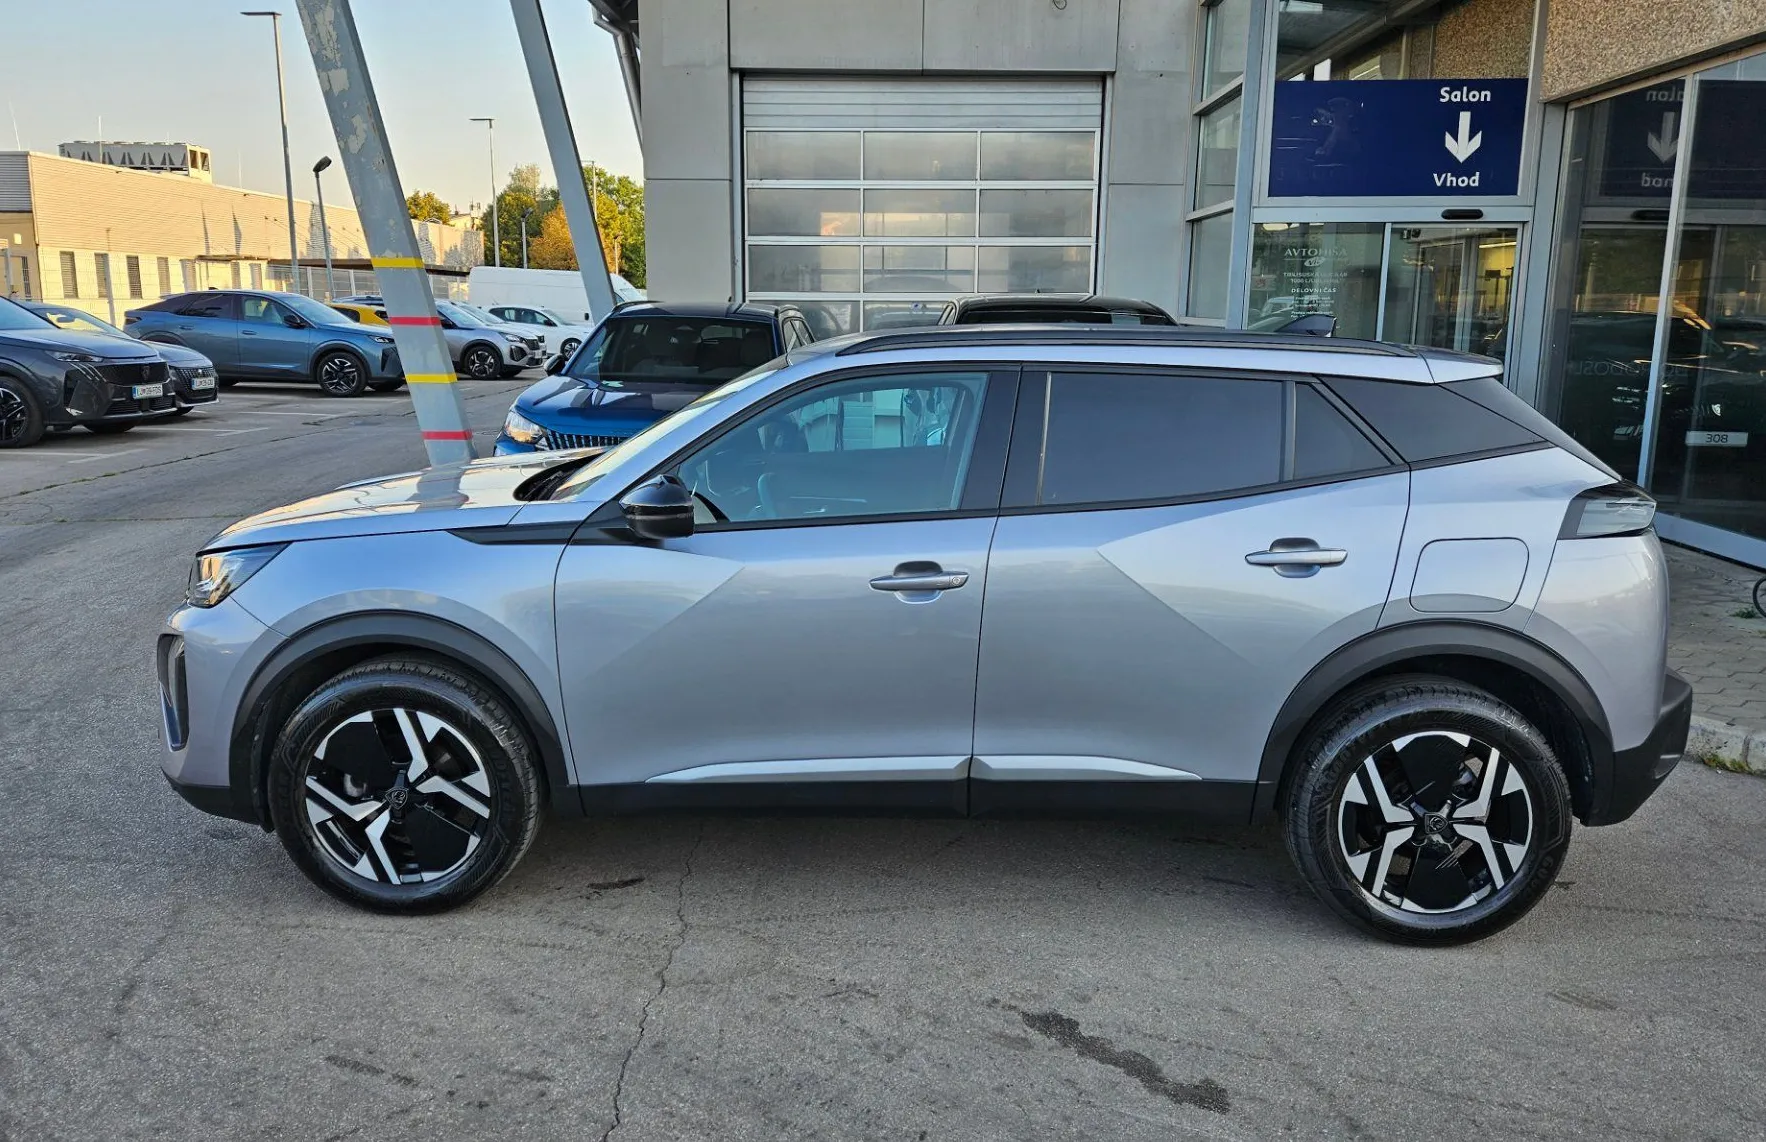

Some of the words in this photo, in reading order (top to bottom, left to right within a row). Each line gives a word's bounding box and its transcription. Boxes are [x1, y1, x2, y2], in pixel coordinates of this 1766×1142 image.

[1439, 86, 1492, 103] Salon
[1433, 171, 1480, 187] Vhod
[1705, 433, 1729, 443] 308
